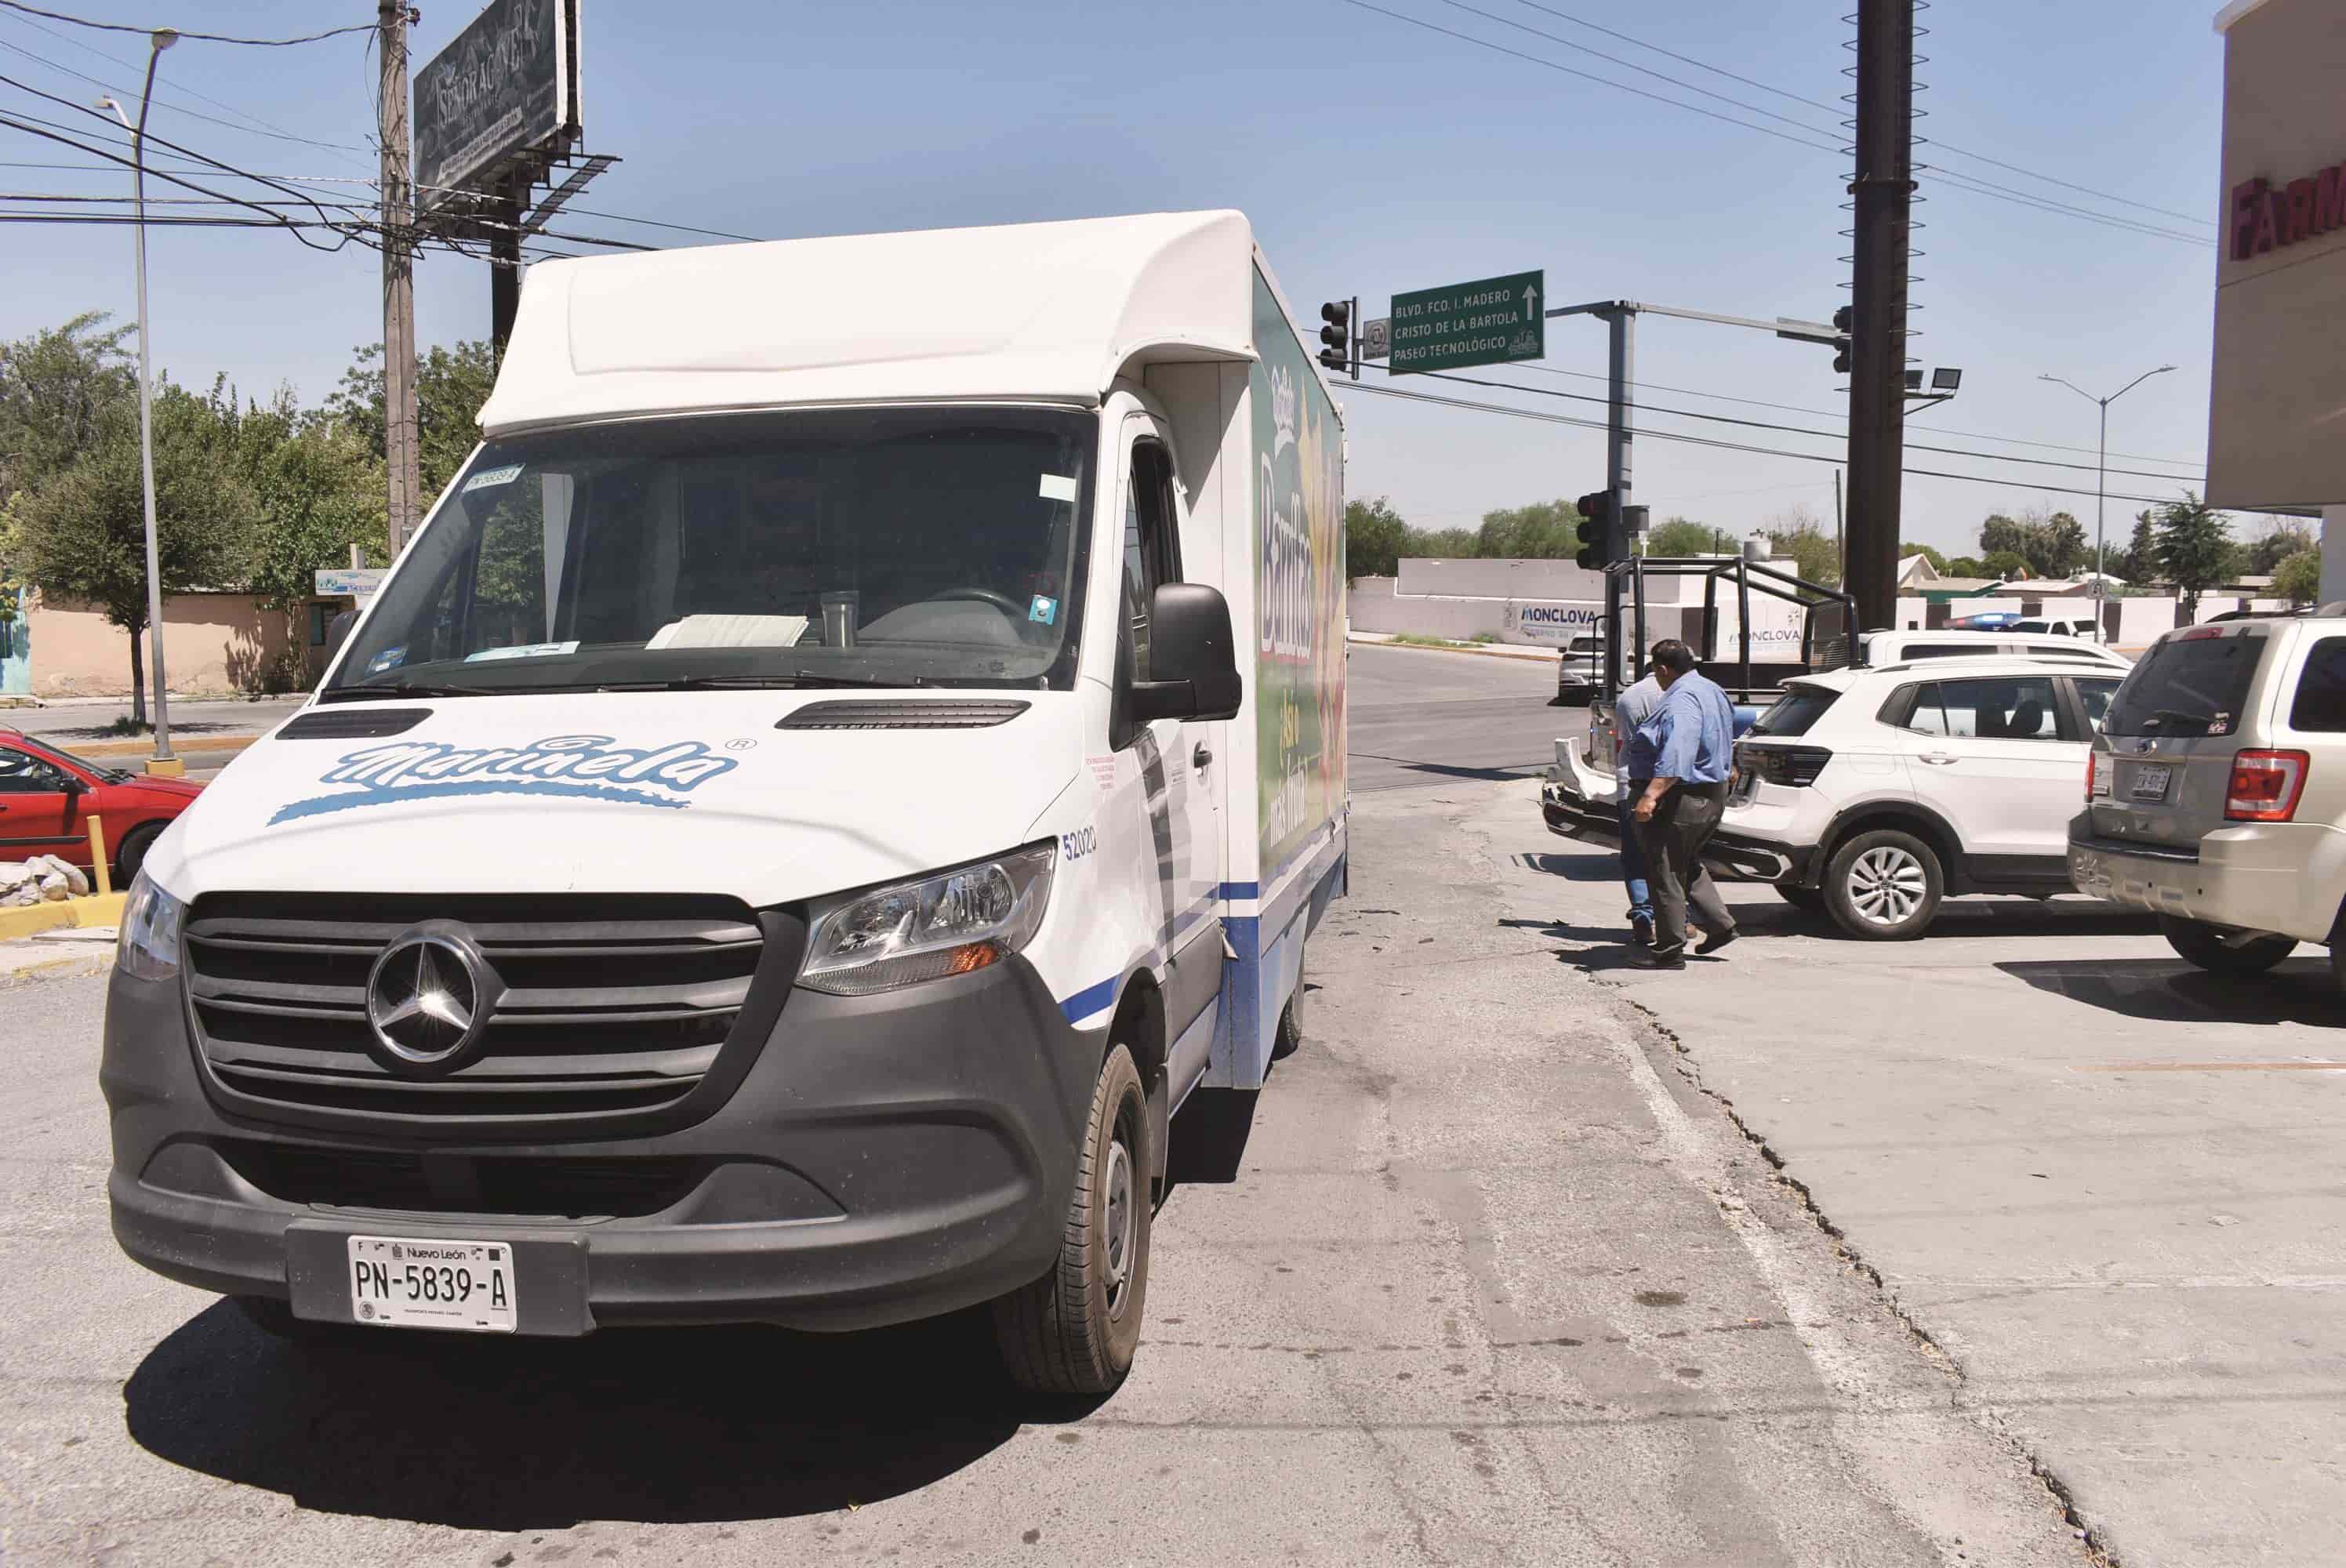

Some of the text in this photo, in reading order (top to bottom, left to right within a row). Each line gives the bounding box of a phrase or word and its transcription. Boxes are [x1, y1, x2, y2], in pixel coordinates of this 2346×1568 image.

[1395, 303, 1424, 318] BLVD.
[1428, 299, 1451, 313] FCO.
[1464, 289, 1510, 308] MADERO
[1395, 311, 1519, 340] CRISTO DE LA BARTOLA
[1394, 346, 1426, 362] PASEO
[1430, 336, 1506, 358] TECNOLÓGICO
[1262, 451, 1312, 659] Barritas
[1521, 605, 1596, 625] MONCLOVA
[318, 735, 739, 792] Marinela
[1062, 826, 1097, 861] 52020
[407, 1247, 467, 1261] Nuevo León
[355, 1261, 507, 1307] PN-5839-A
